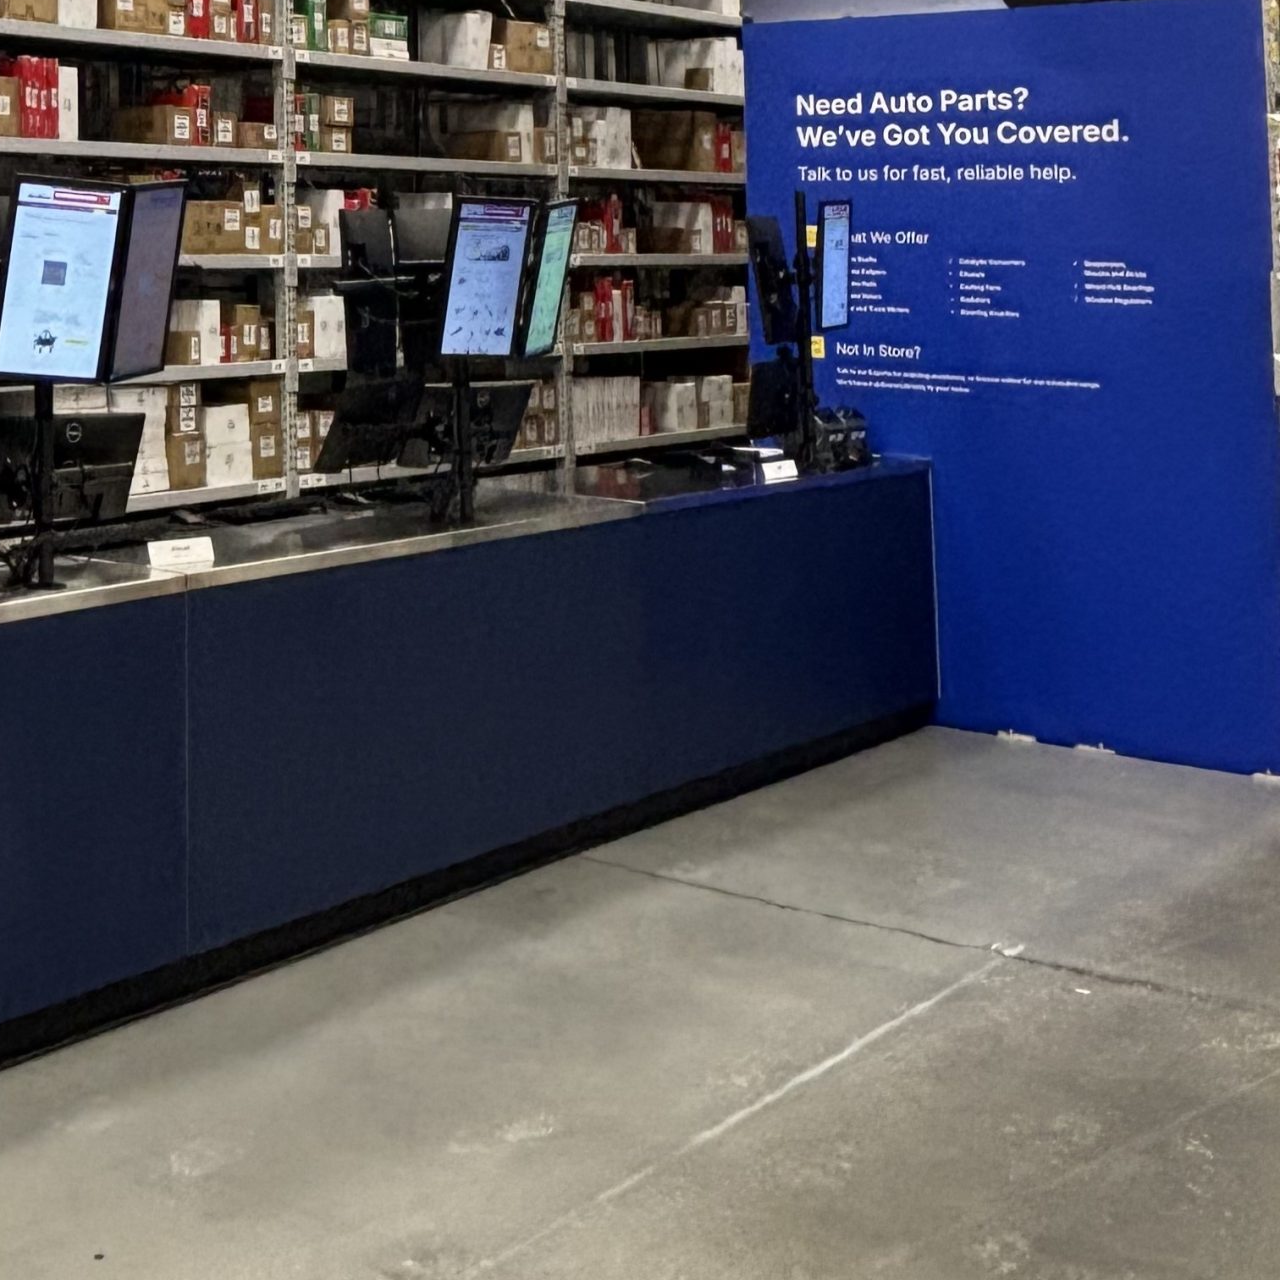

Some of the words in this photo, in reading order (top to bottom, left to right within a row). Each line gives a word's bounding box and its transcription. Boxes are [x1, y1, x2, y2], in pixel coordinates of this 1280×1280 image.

[796, 92, 863, 116] Need
[869, 91, 933, 115] Auto
[940, 86, 1029, 112] Parts?
[796, 124, 876, 148] We've
[882, 123, 931, 146] Got
[936, 122, 990, 145] You
[996, 118, 1130, 145] Covered.
[798, 165, 832, 182] Talk
[835, 167, 853, 182] to
[858, 168, 879, 182] us
[883, 164, 907, 182] for
[912, 164, 951, 184] fast,
[957, 164, 1024, 181] reliable
[1030, 163, 1077, 184] help.
[870, 231, 892, 245] We
[895, 231, 930, 245] Offer
[836, 341, 860, 356] Not
[863, 343, 875, 357] In
[879, 344, 921, 360] Store?
